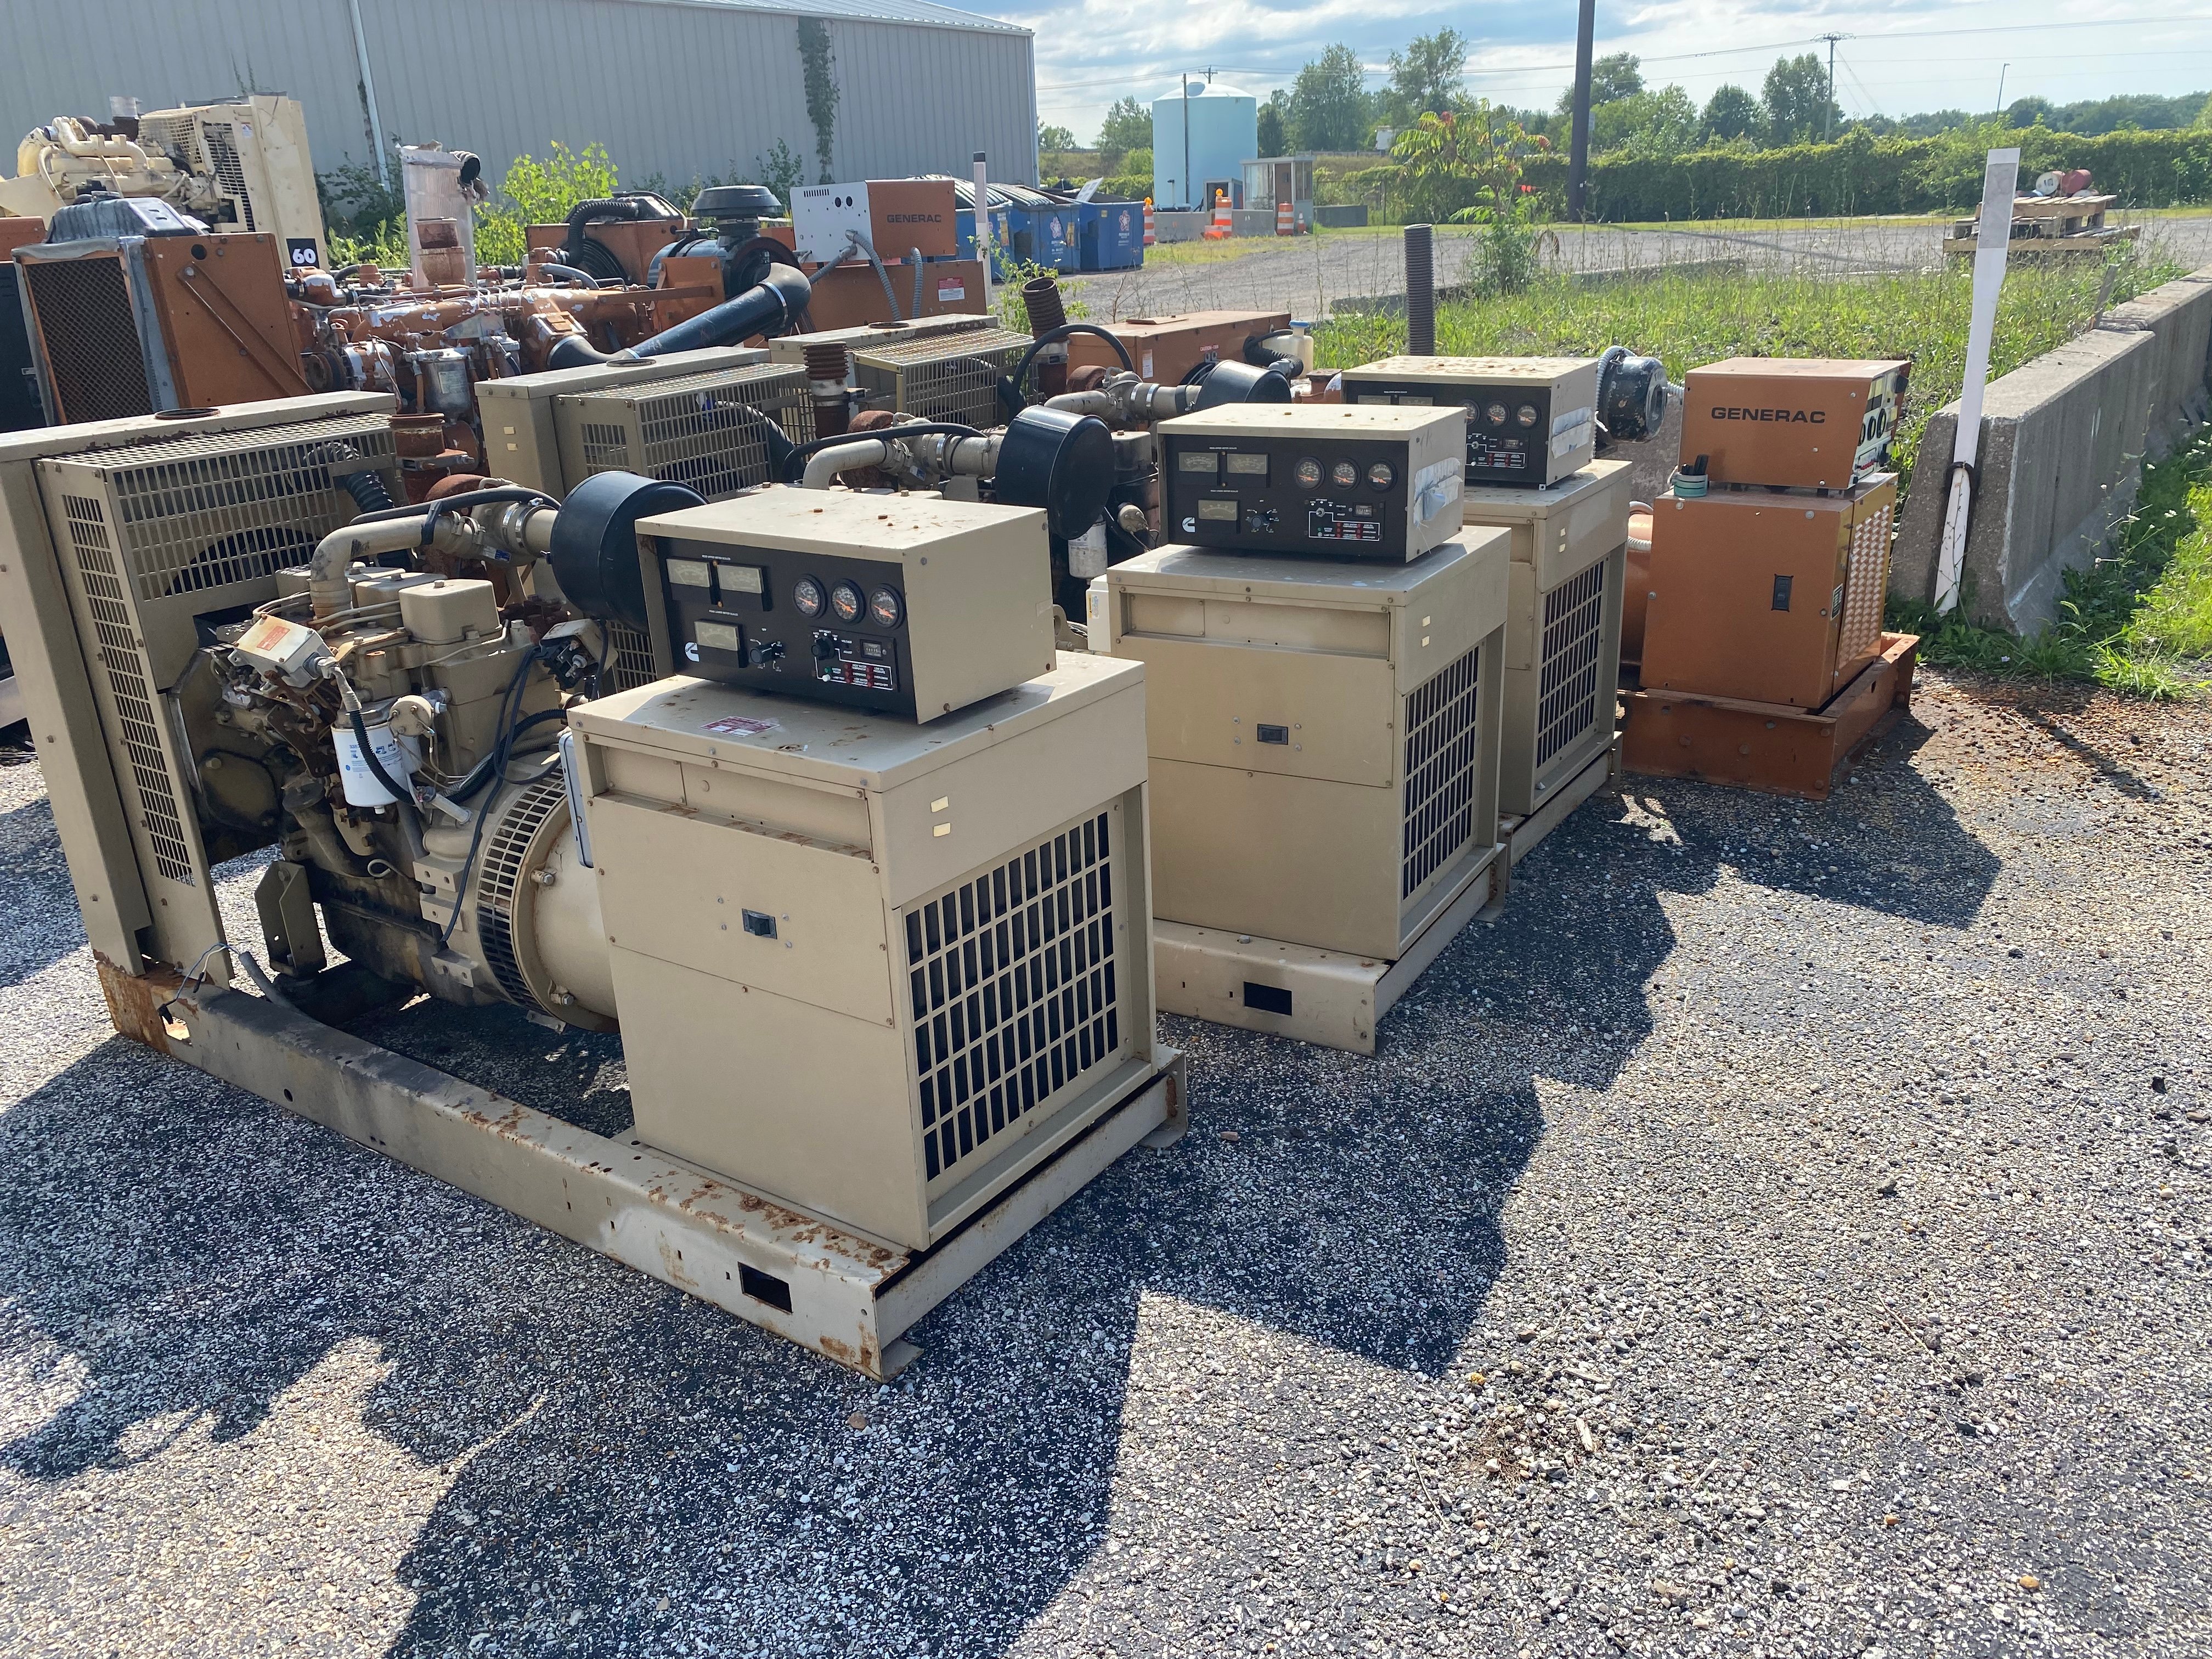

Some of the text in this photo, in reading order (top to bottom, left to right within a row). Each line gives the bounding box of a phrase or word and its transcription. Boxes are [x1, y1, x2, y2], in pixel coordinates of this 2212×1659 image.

[887, 214, 941, 223] GENERAC
[292, 248, 317, 264] 60
[1711, 407, 1826, 424] GENERAC
